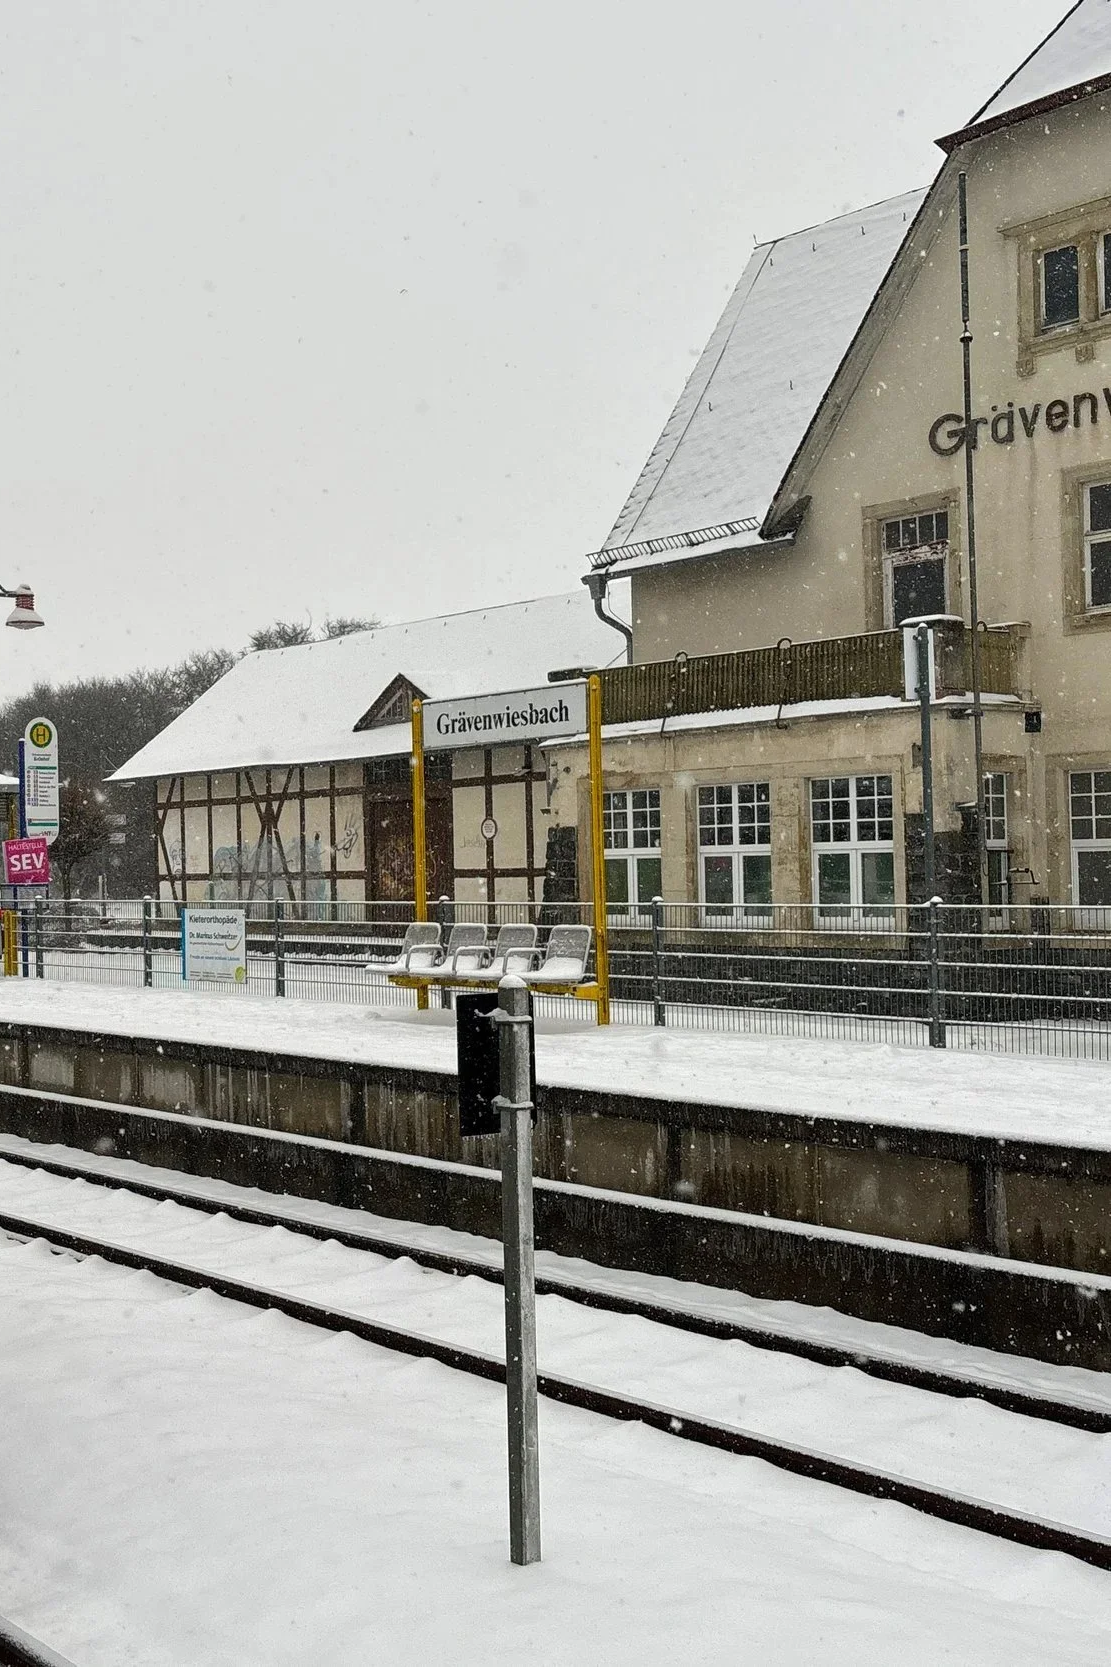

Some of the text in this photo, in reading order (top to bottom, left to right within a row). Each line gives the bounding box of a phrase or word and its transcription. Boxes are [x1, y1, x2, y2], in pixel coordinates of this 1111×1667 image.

[928, 387, 1111, 457] Gräven
[436, 700, 570, 735] Grävenwiesbach
[8, 841, 44, 851] HALTESTELLE
[9, 852, 45, 871] SEV
[188, 914, 238, 925] Kieferorthopäde
